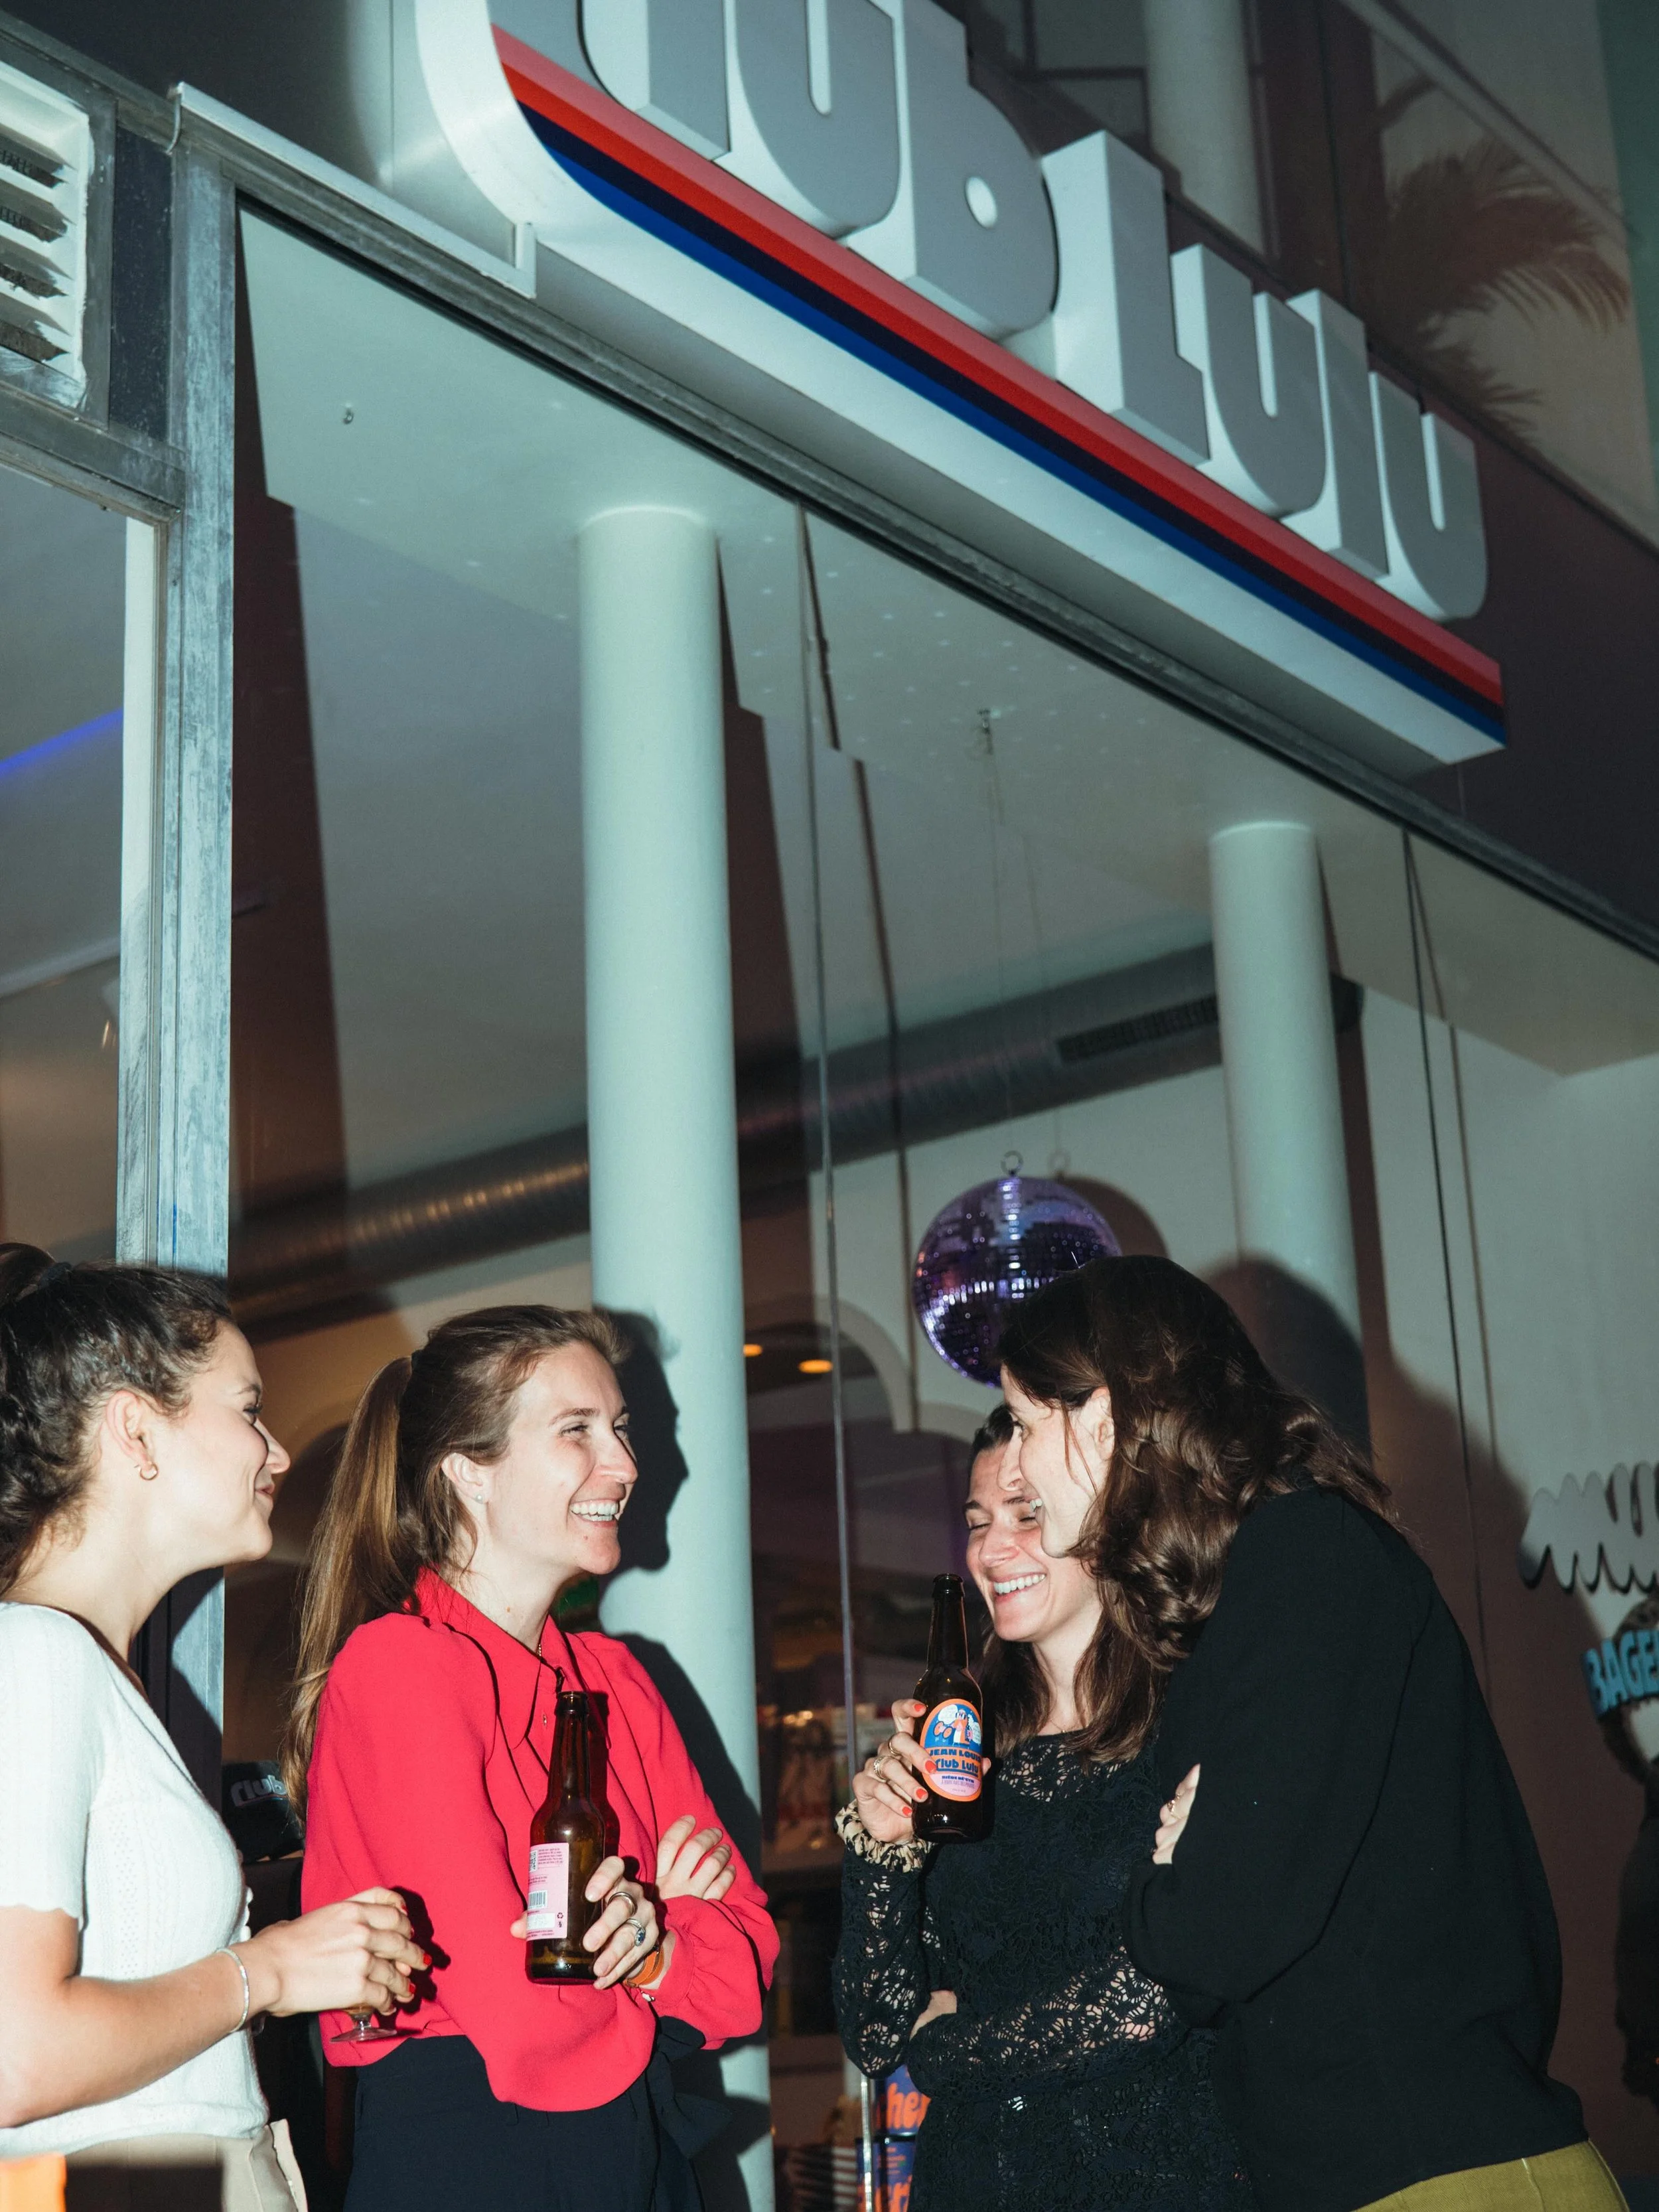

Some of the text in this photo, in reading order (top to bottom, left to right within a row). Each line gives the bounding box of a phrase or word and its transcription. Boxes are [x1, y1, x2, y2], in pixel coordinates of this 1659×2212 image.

[1042, 131, 1488, 621] Lulu
[1584, 1629, 1659, 1715] BAGE
[935, 1758, 979, 1774] Club Lulu
